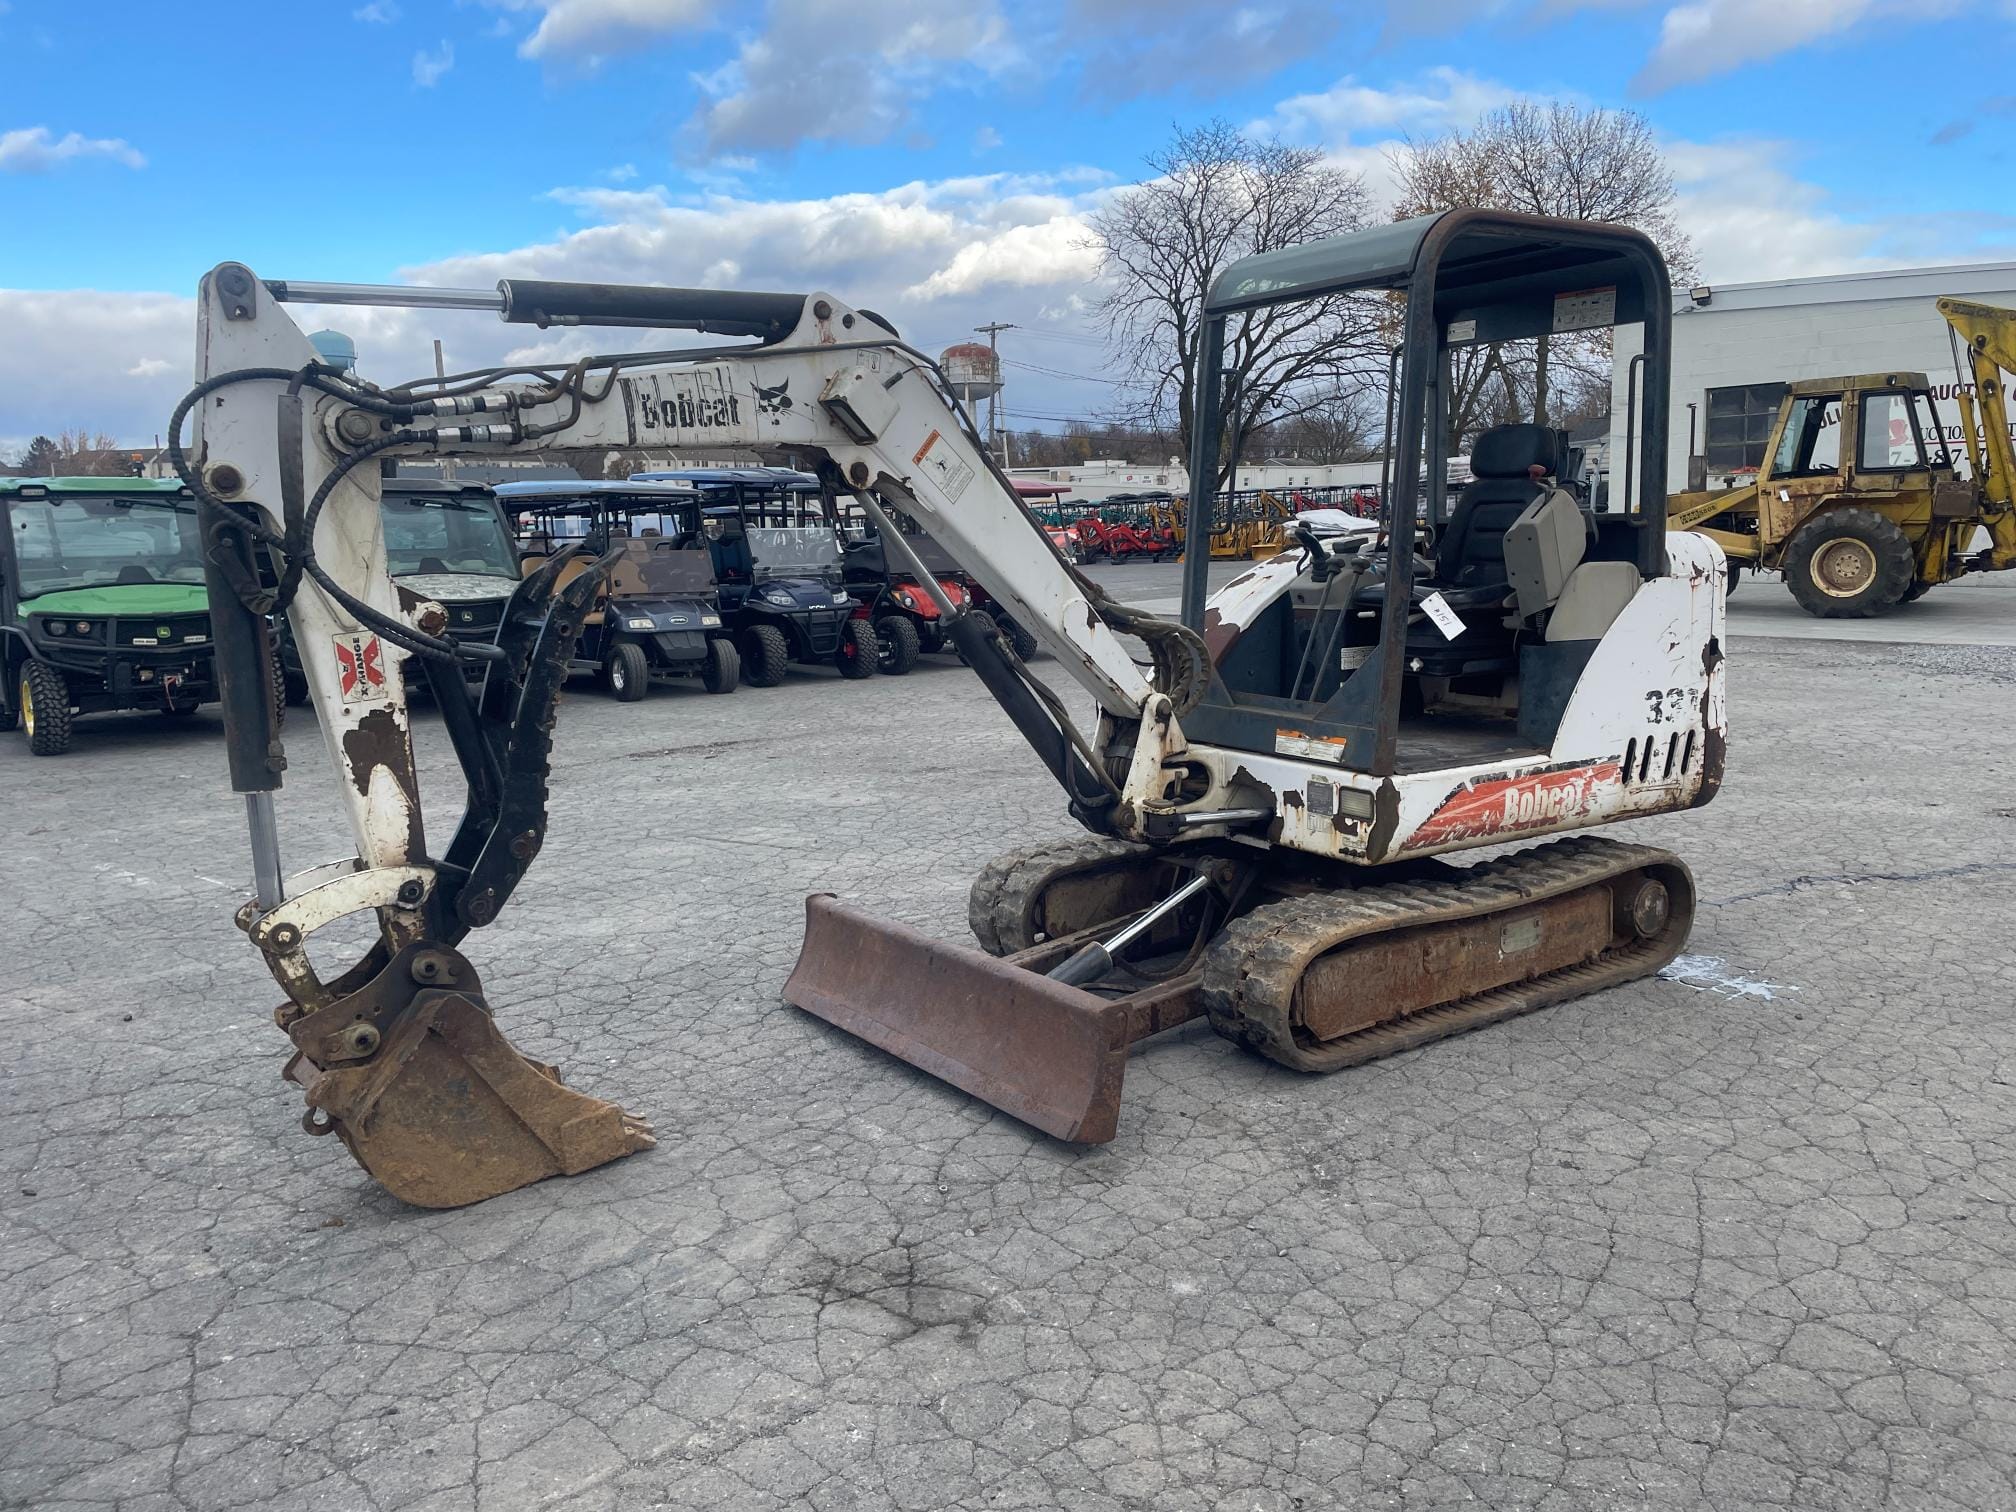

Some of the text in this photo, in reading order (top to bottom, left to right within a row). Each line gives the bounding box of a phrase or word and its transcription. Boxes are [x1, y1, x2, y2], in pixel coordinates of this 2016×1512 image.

[641, 392, 741, 429] Bobcat
[352, 636, 369, 696] X-CHANGE
[1499, 778, 1586, 827] Bobcat
